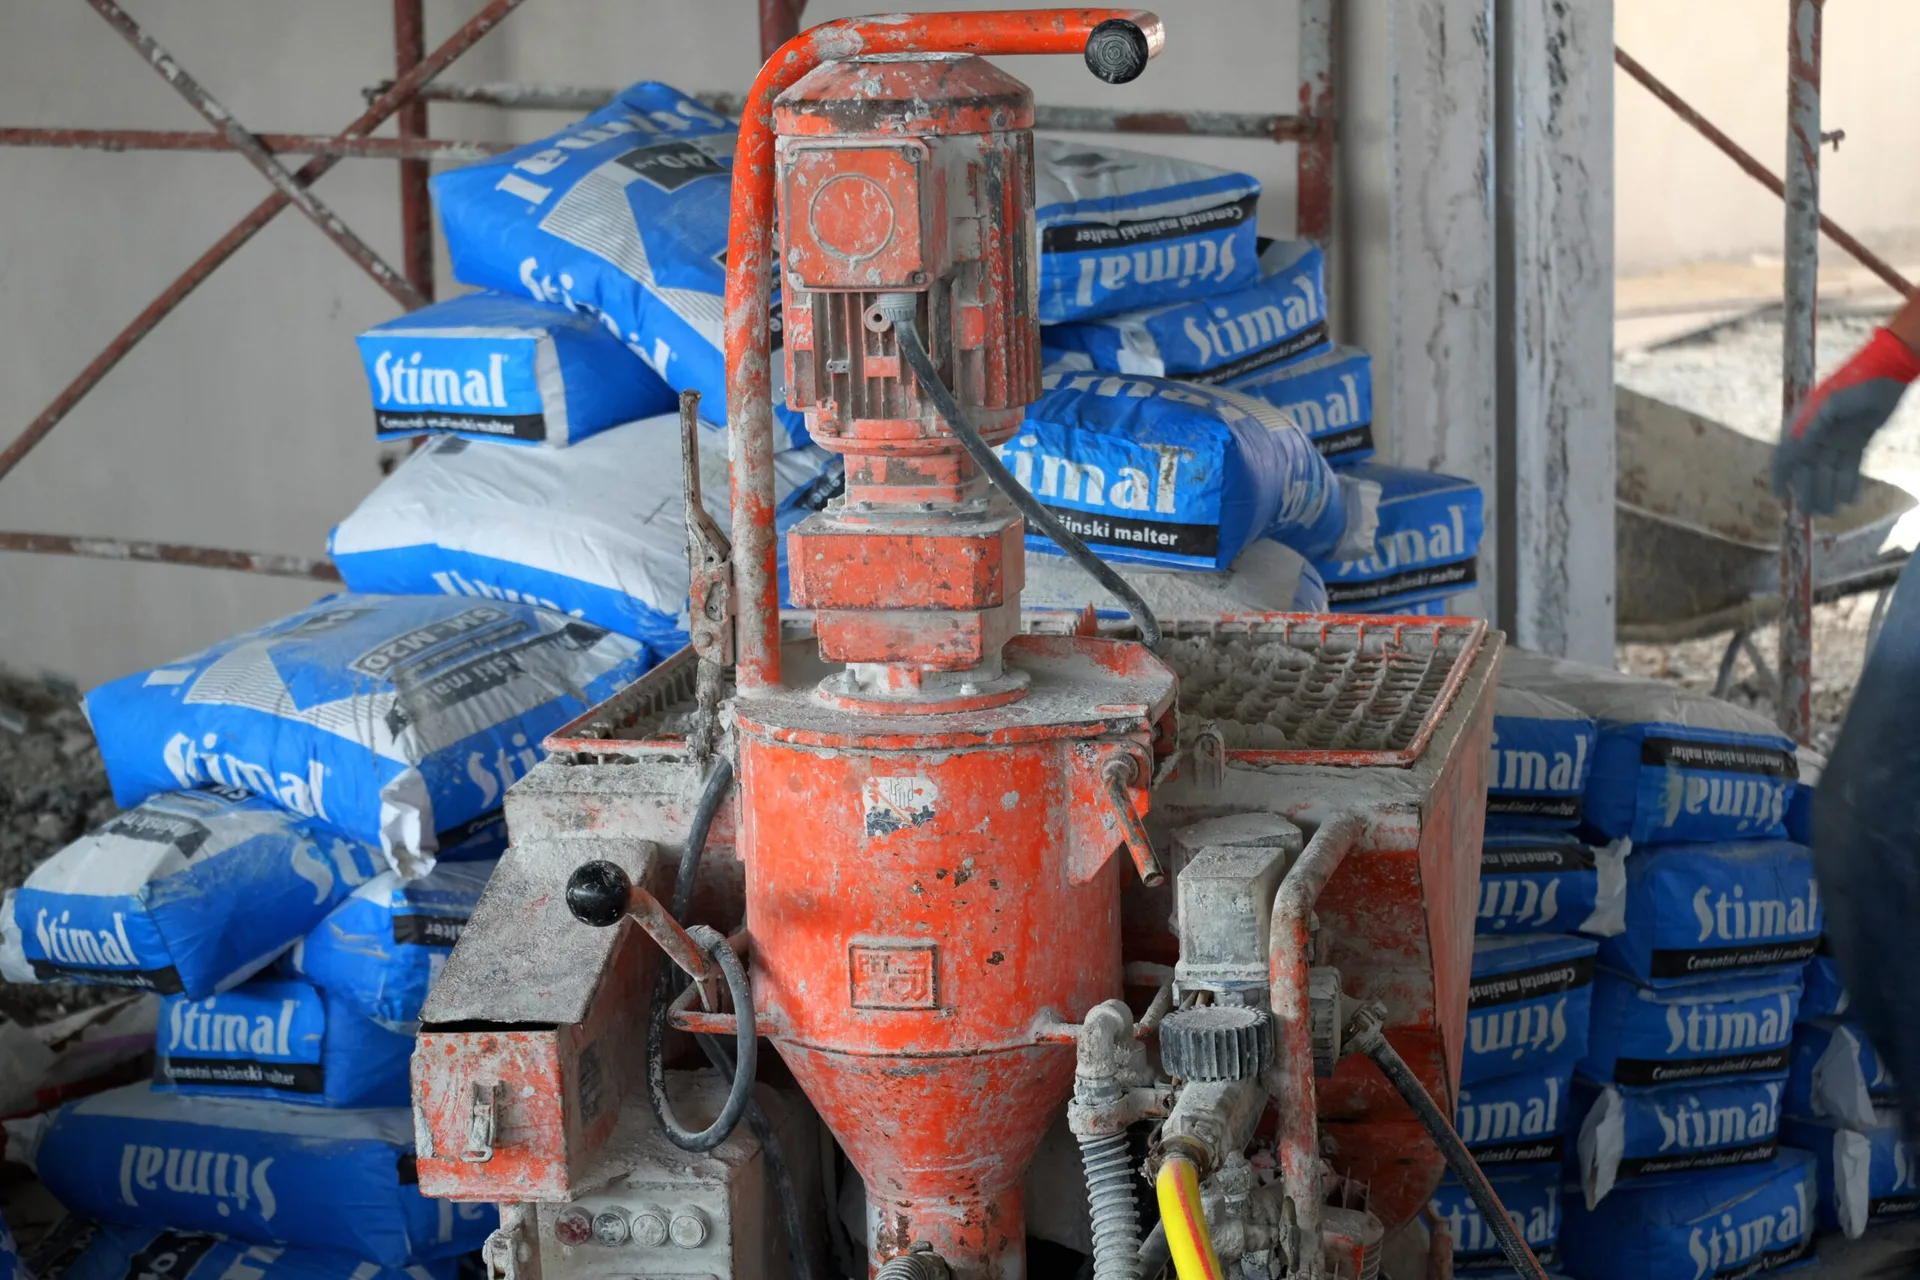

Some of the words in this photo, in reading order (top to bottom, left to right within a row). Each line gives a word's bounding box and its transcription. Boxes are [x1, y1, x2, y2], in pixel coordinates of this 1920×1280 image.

[1180, 206, 1243, 230] Cementni
[1076, 234, 1236, 306] Stimal
[1184, 276, 1318, 365] Stimal
[375, 351, 508, 408] Stimal
[1114, 526, 1178, 545] malter
[164, 732, 332, 823] Stimal
[1663, 773, 1786, 833] Stimal
[36, 908, 140, 966] Stimal
[1693, 878, 1819, 943] Stimal
[1520, 967, 1576, 993] Cementni
[169, 996, 291, 1055] Stimal
[1469, 997, 1567, 1059] Stim
[1665, 992, 1791, 1055] Stimal
[1458, 1076, 1559, 1143] imal
[1653, 1082, 1780, 1152] Stimal
[119, 1144, 277, 1222] Stimal
